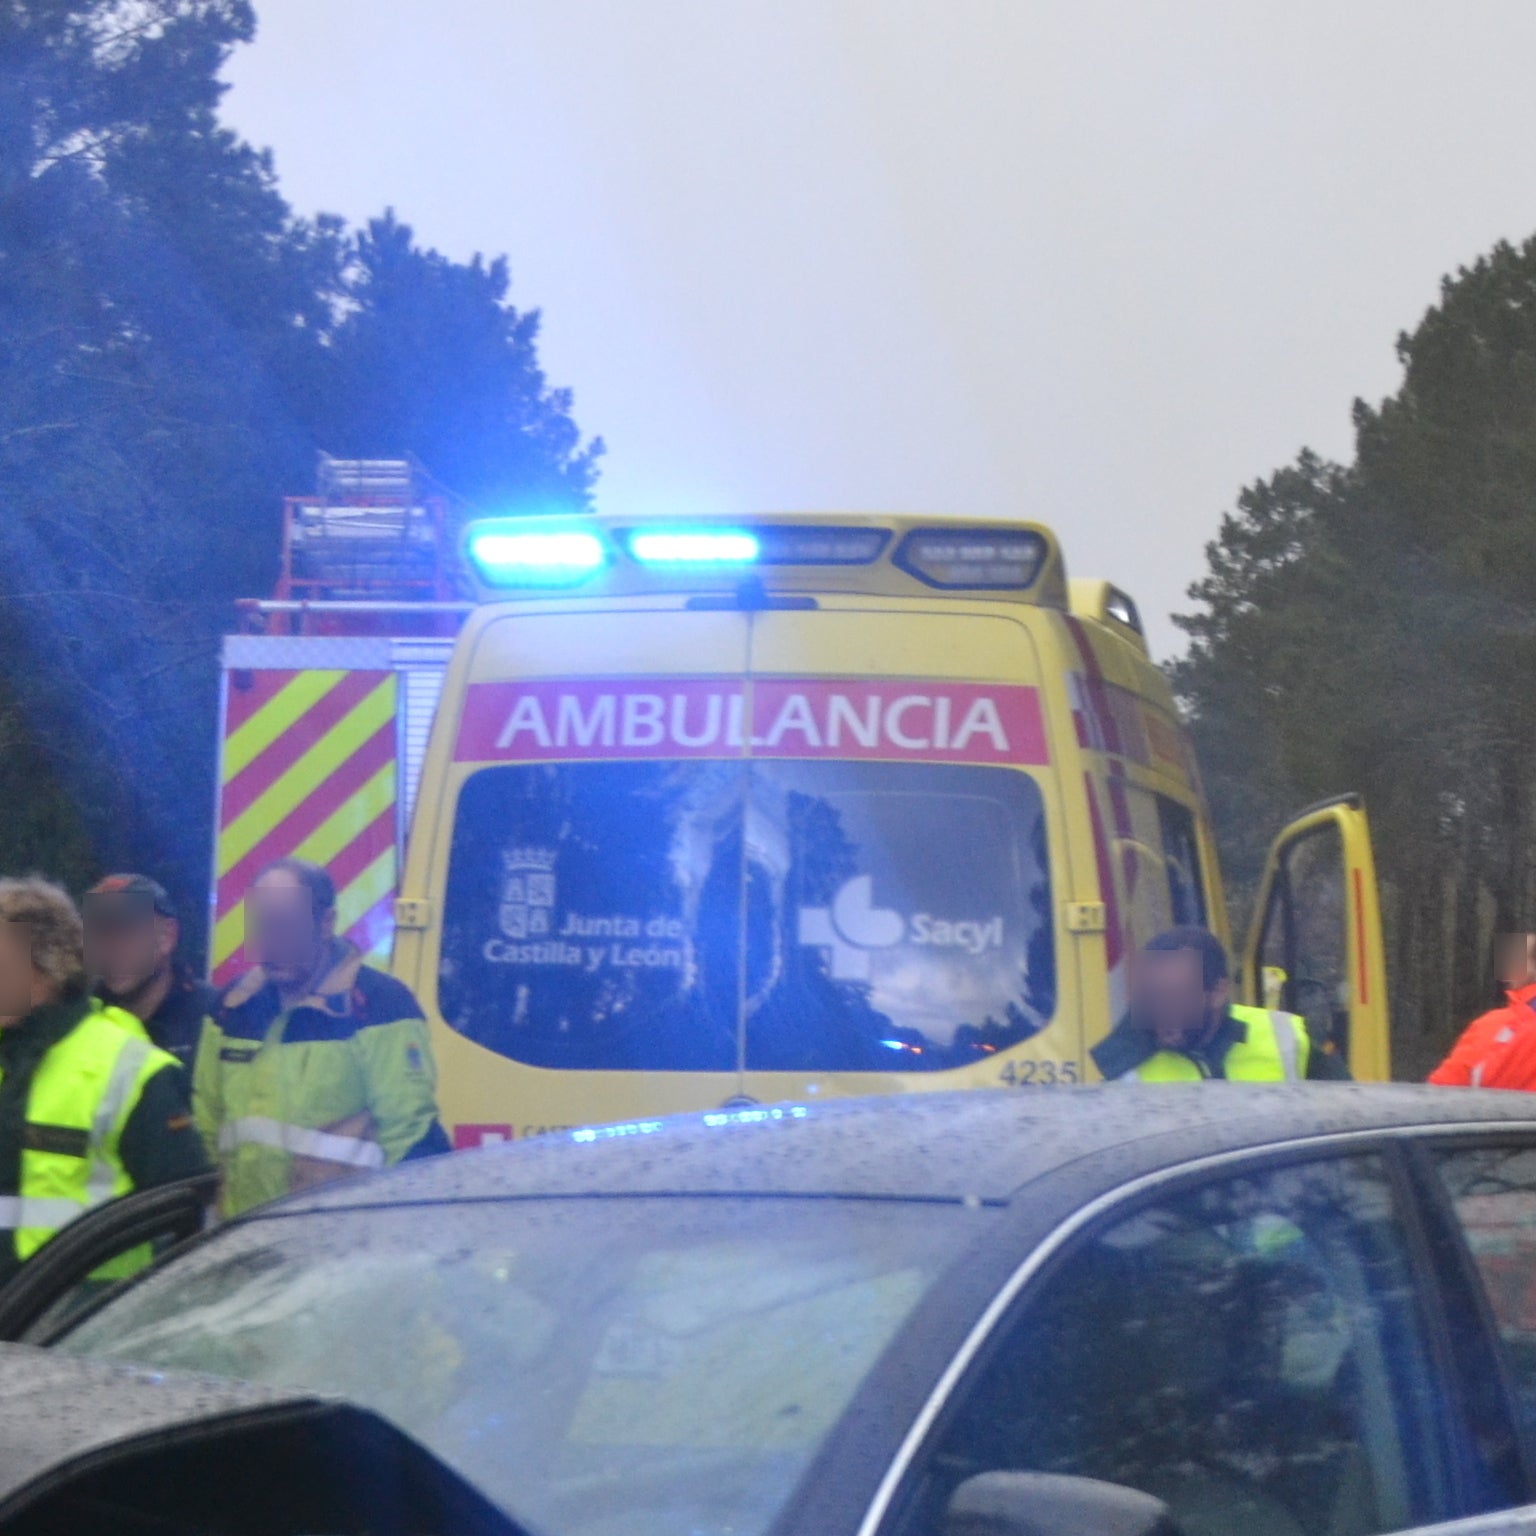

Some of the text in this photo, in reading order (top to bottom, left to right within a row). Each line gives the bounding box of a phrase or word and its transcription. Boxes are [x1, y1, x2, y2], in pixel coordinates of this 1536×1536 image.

[495, 693, 1009, 752] AMBULANCIA
[560, 914, 683, 937] Junta de
[911, 912, 1003, 954] Sacyl
[484, 940, 680, 972] Castilla y León
[999, 1060, 1078, 1086] 4235
